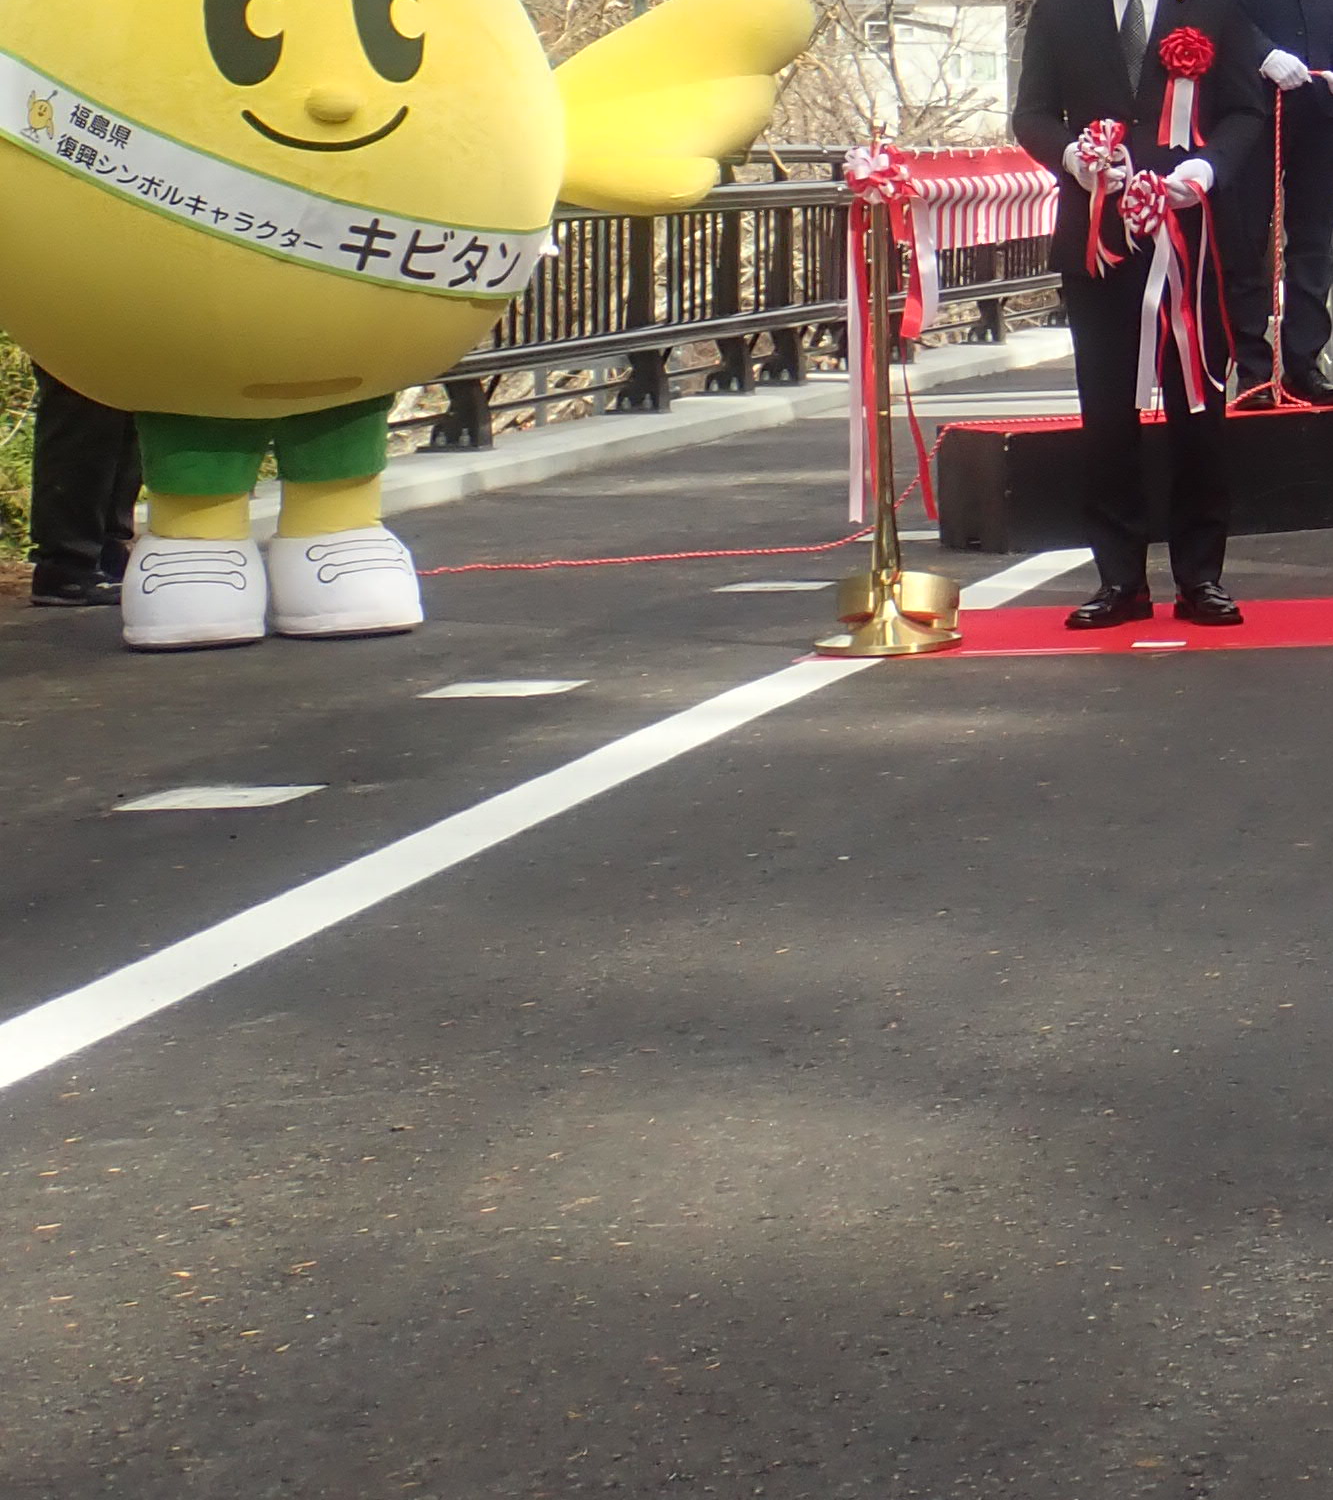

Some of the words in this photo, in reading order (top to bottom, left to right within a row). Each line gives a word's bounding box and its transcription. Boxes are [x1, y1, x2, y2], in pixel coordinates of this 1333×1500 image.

[69, 103, 132, 150] 福島県
[55, 133, 324, 249] 復興シンボルキャラクター
[339, 217, 522, 288] キビタン
